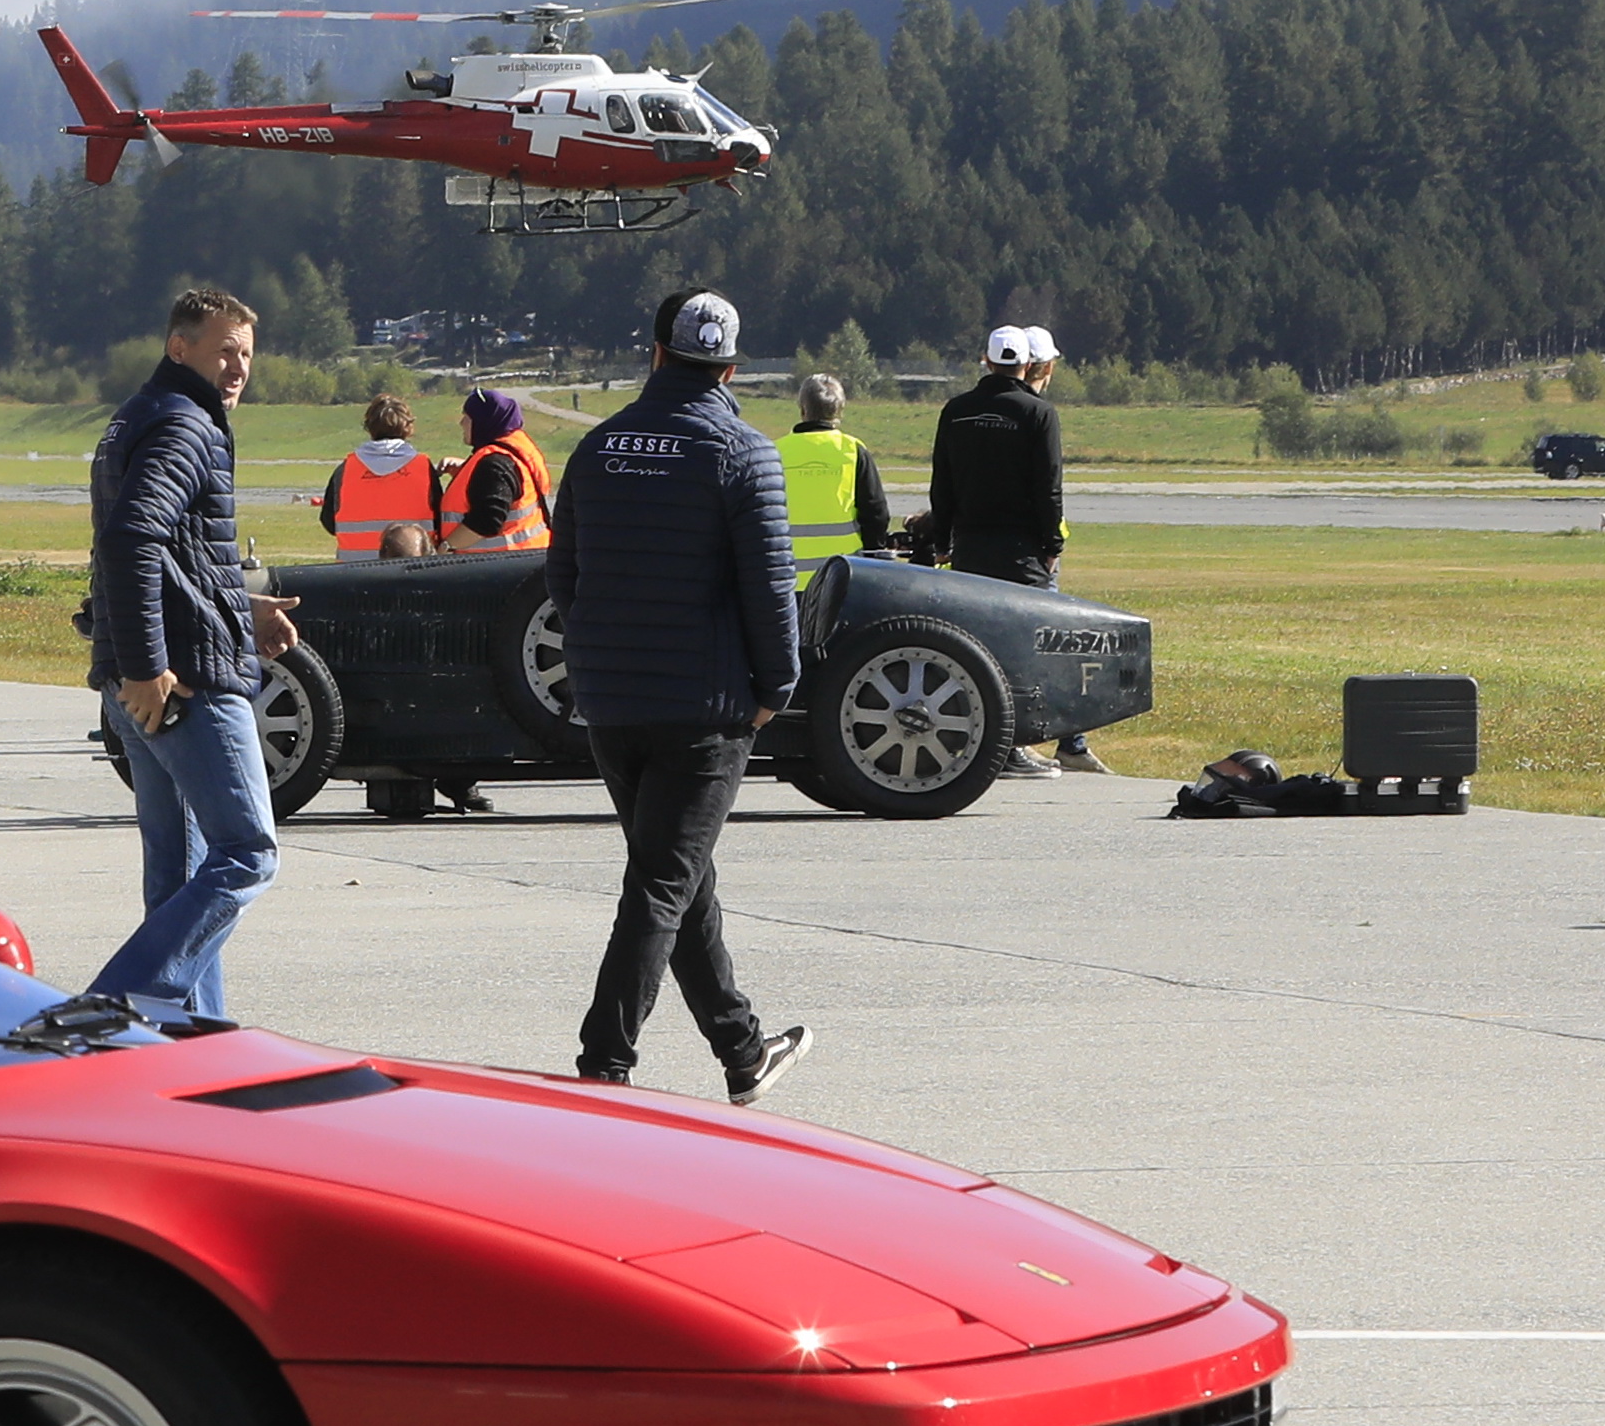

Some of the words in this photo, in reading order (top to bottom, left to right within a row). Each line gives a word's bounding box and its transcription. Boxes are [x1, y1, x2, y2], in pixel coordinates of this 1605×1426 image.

[258, 127, 335, 144] HB-ZIB
[604, 436, 682, 453] KESSEL
[1080, 662, 1103, 696] F
